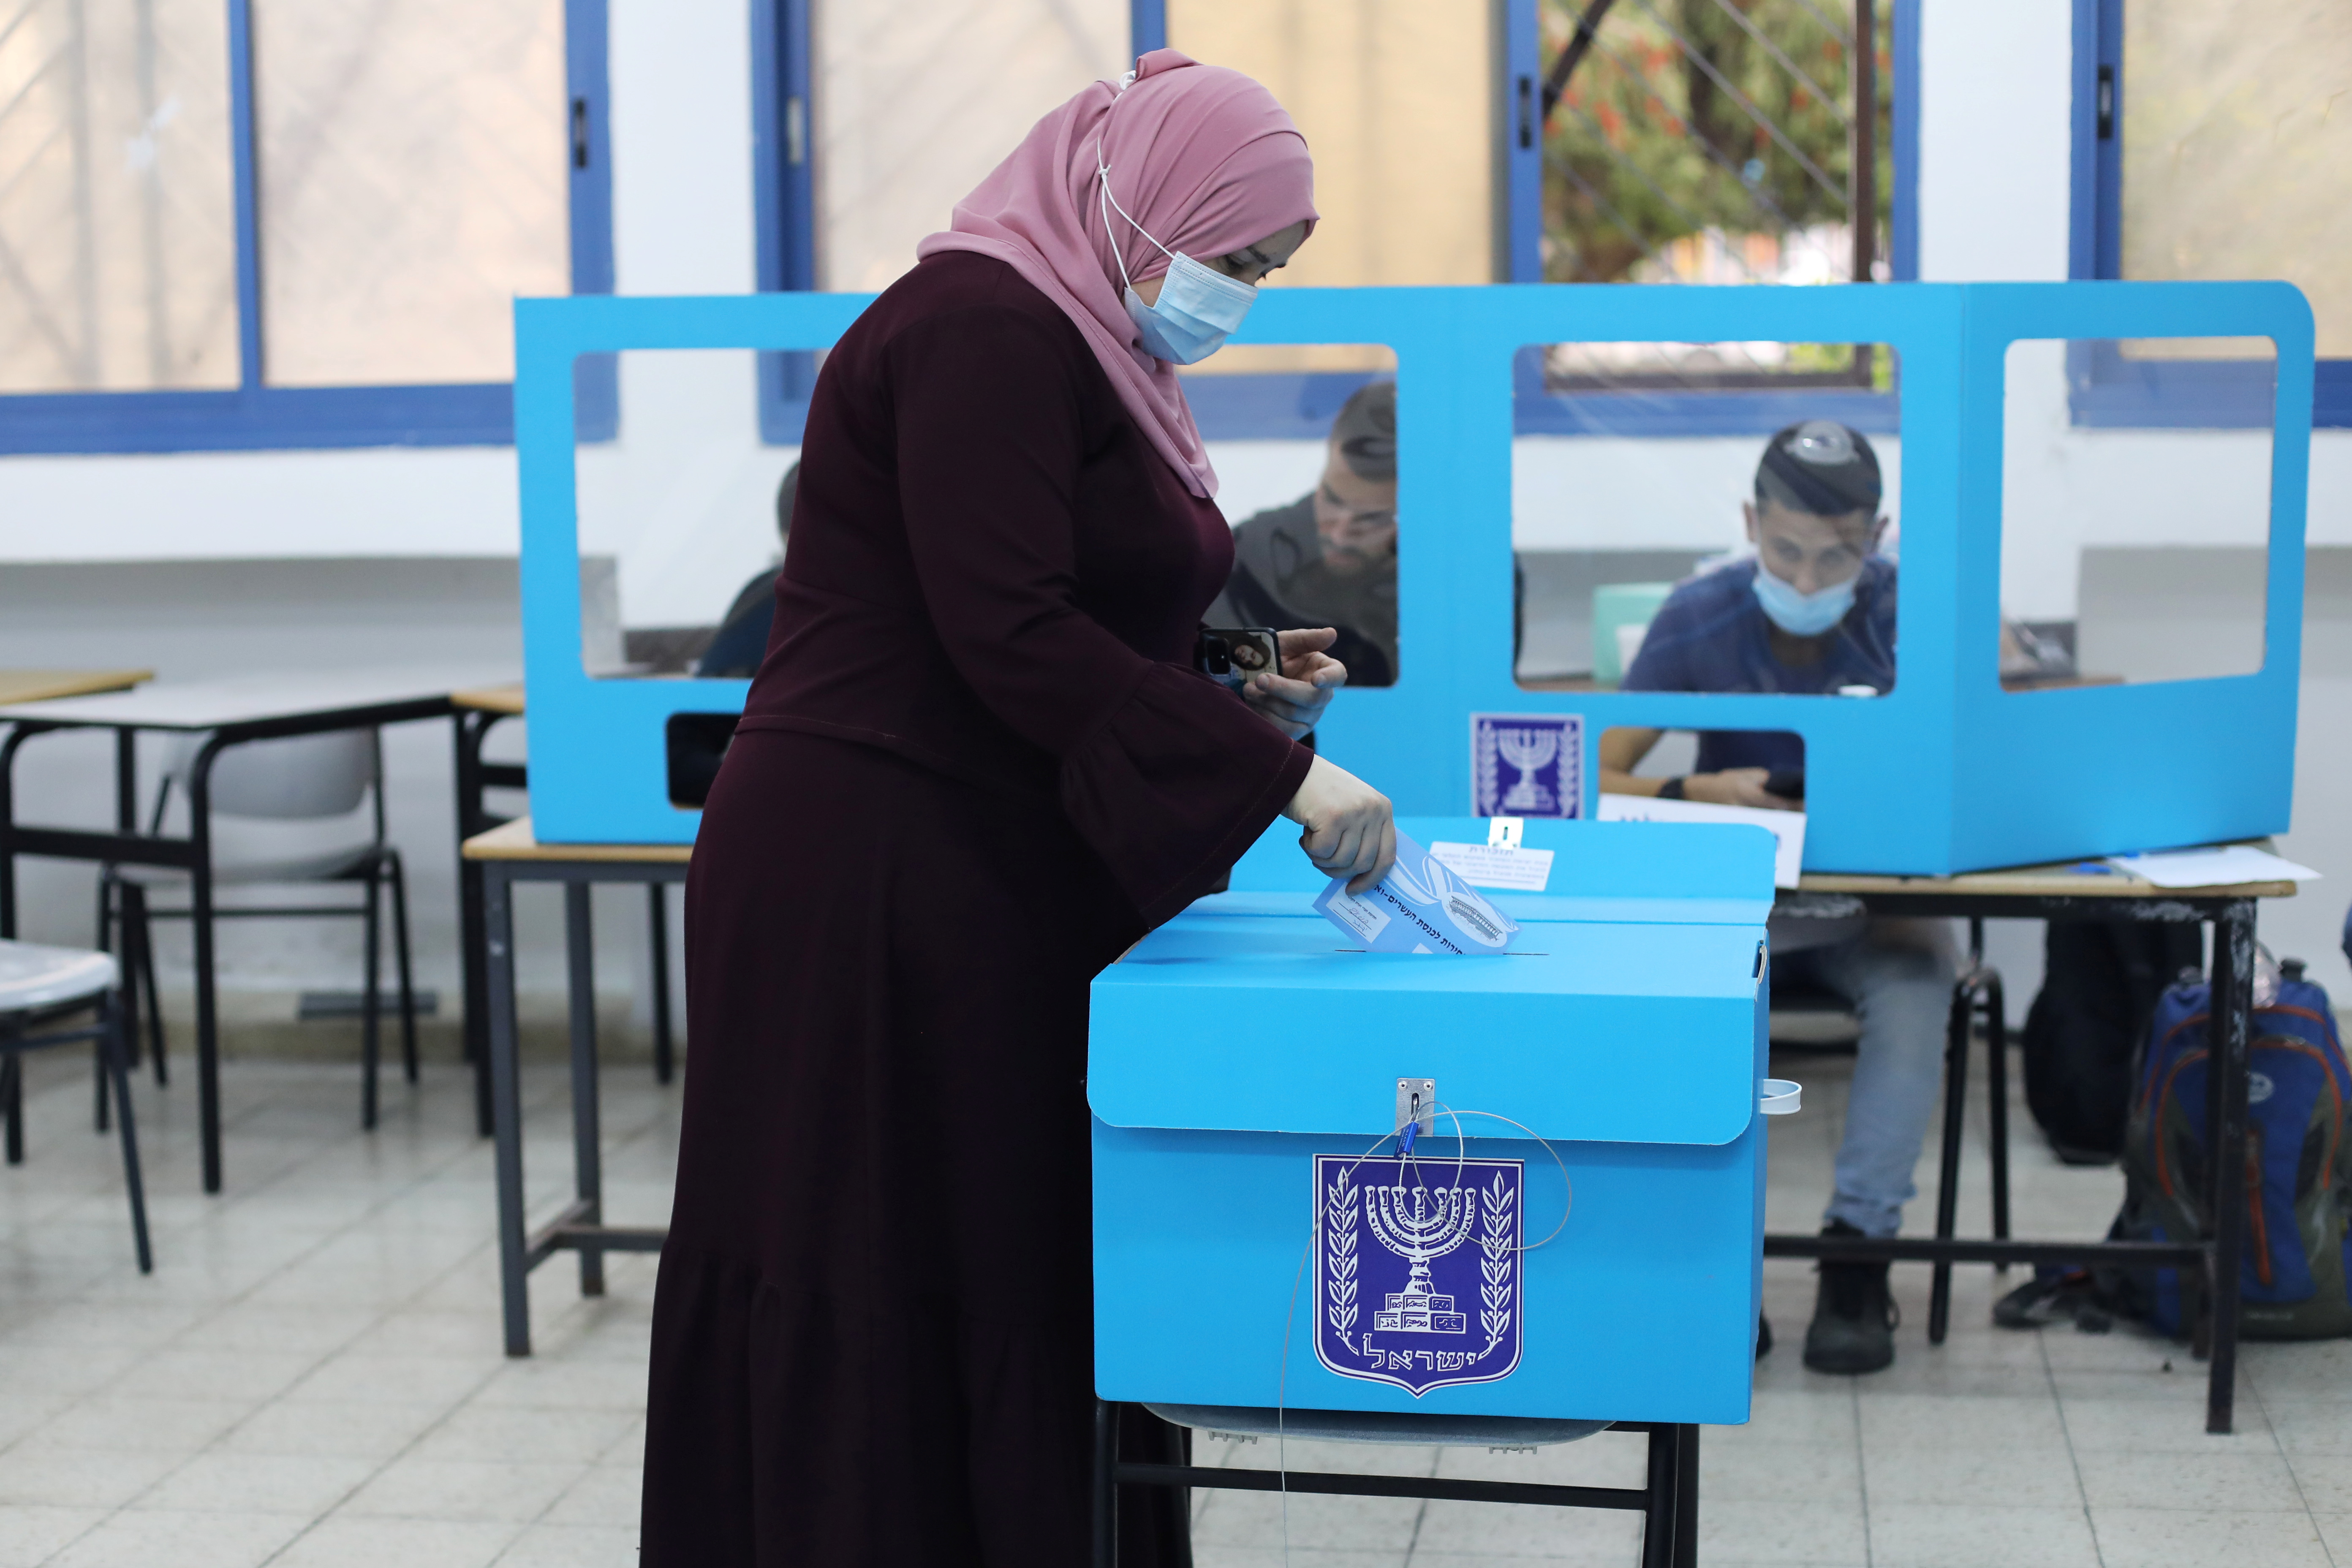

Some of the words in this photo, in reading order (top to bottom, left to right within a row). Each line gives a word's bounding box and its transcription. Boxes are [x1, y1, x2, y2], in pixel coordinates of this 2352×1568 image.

[1374, 884, 1417, 921] העשרים-וא
[1416, 919, 1441, 939] לכנסת
[1440, 938, 1466, 954] חירות
[1362, 1333, 1476, 1372] ישראל
